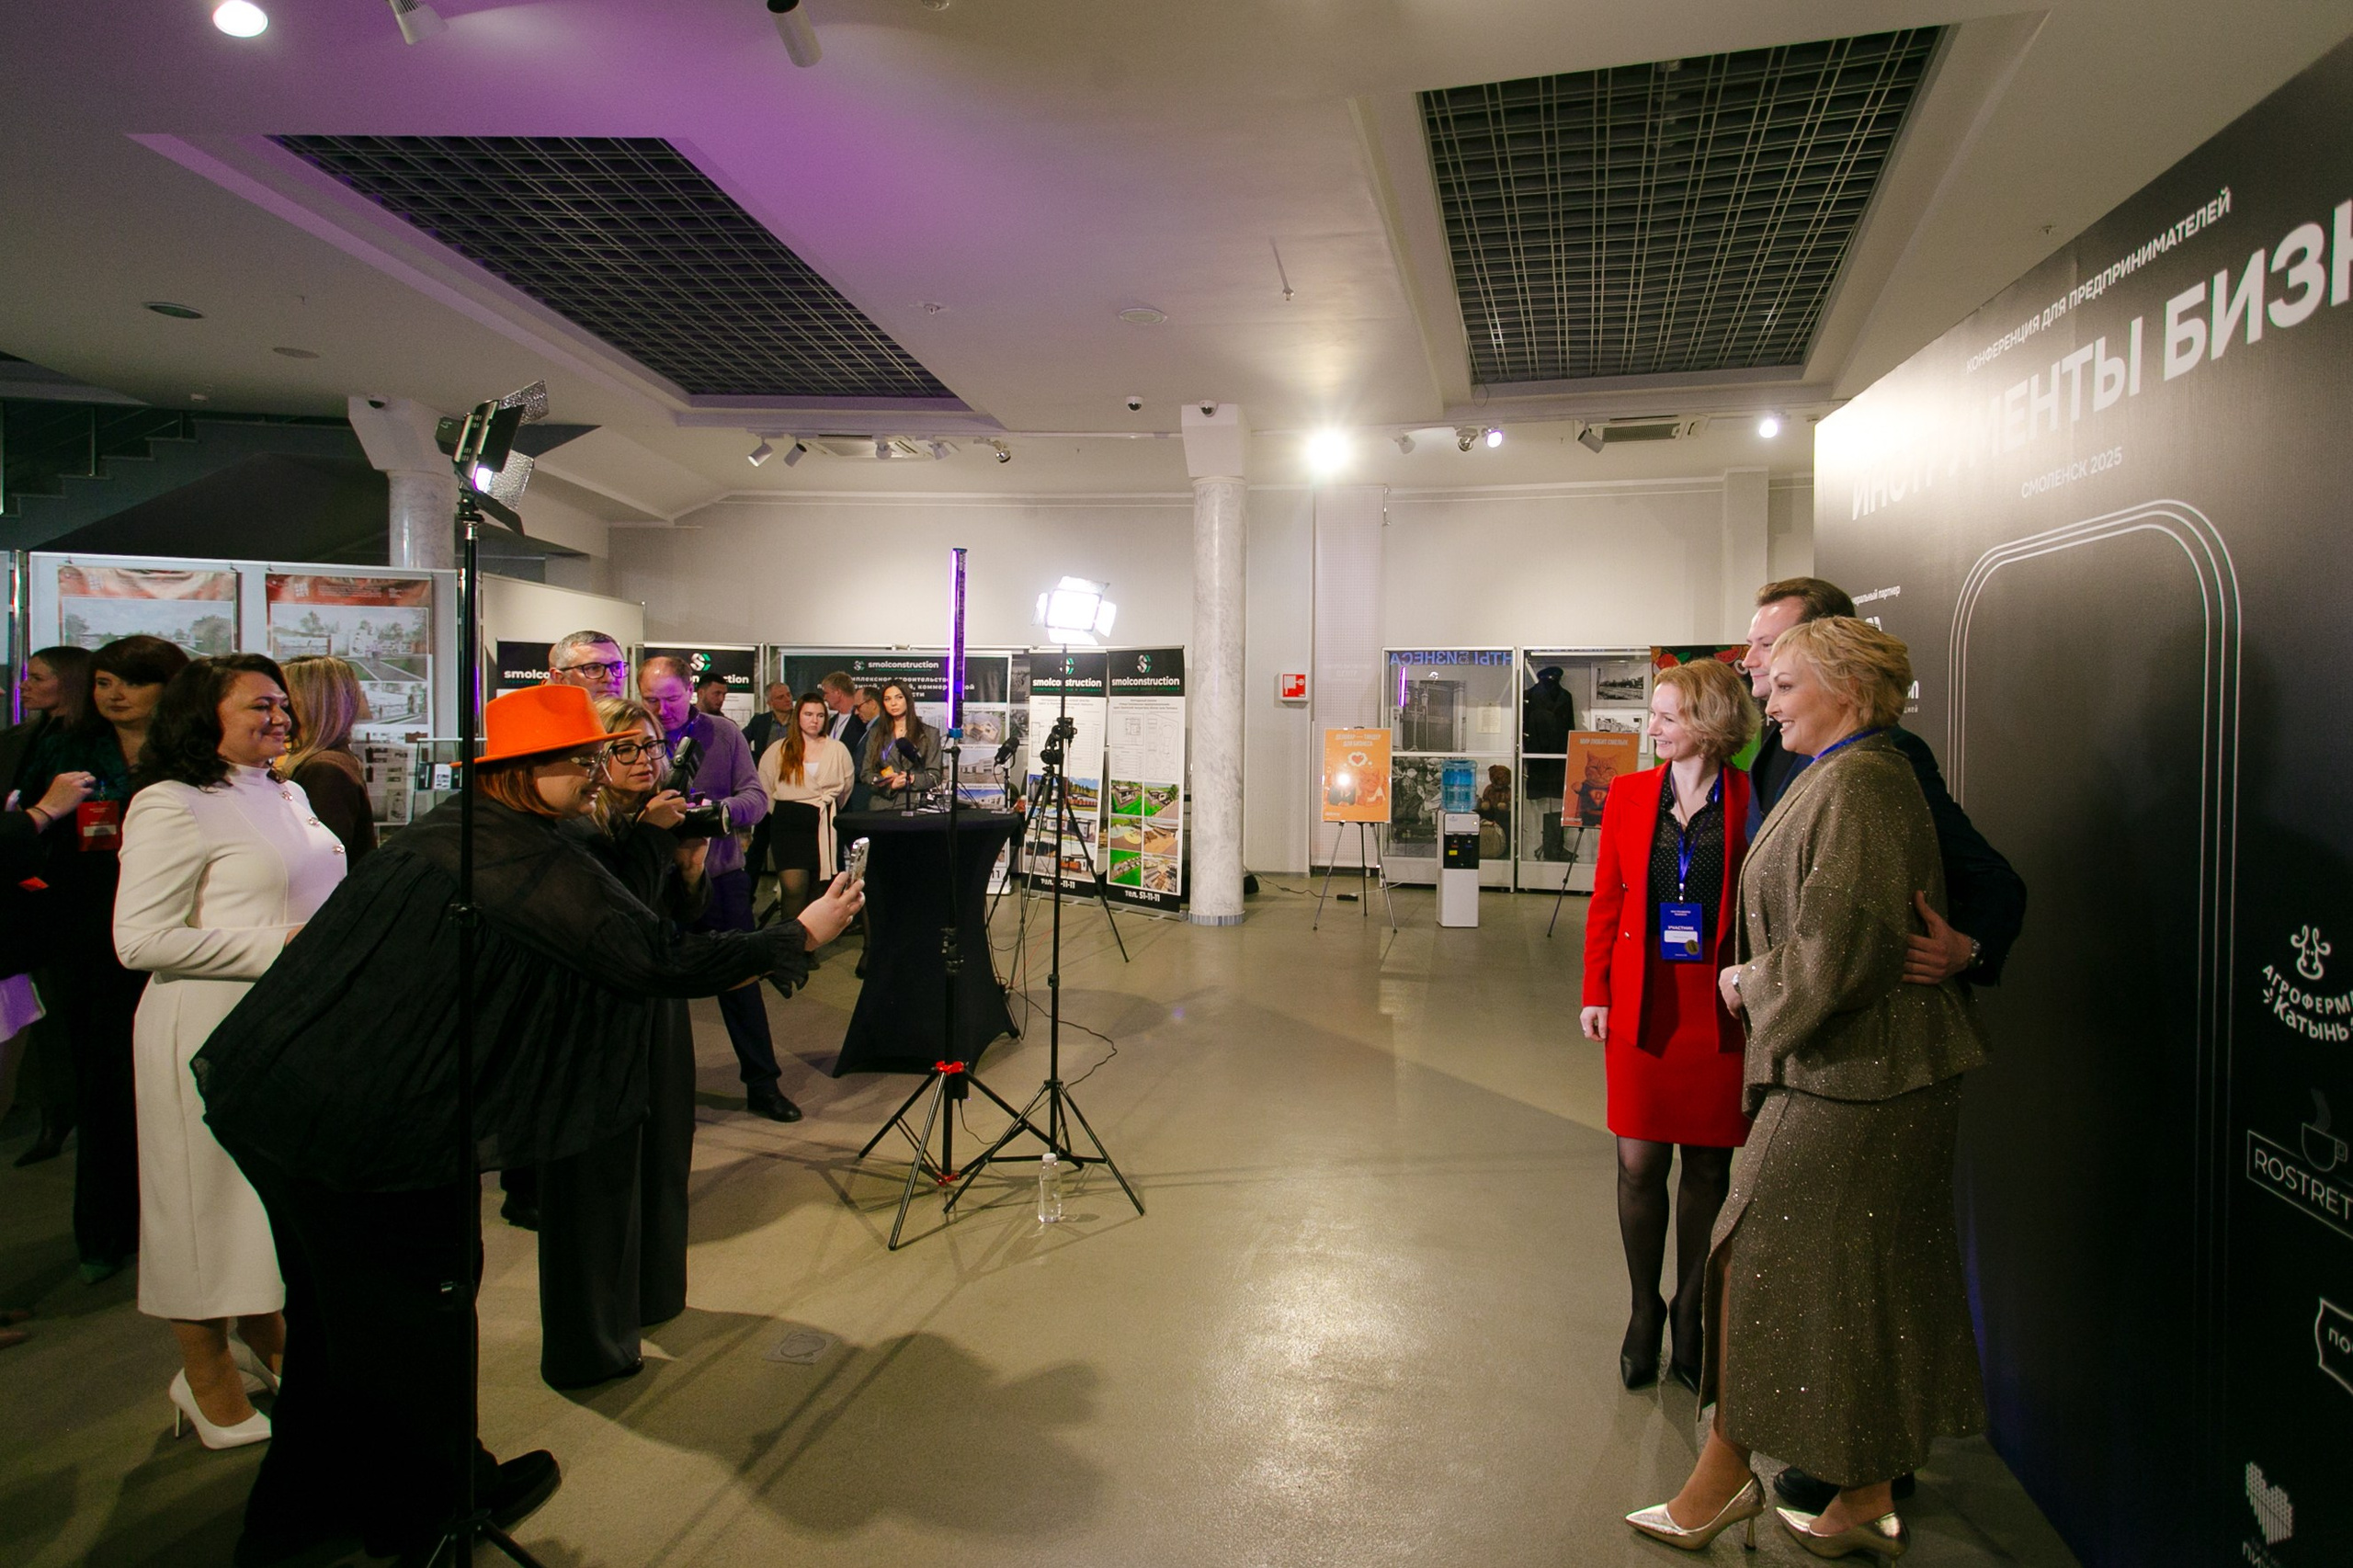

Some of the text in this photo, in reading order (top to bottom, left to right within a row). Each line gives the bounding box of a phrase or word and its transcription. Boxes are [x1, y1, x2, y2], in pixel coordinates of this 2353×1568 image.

[1966, 186, 2232, 374] КОНФЕРЕНЦИЯ ДЛЯ ПРЕДПРИНИМАТЕЛЕЙ
[2021, 447, 2122, 499] СМОЛЕНСК 2025
[868, 660, 939, 669] smolconstruction
[1032, 676, 1102, 687] smolcostruction
[1111, 676, 1180, 687] smolconstruction
[1139, 892, 1161, 902] 51-11-11
